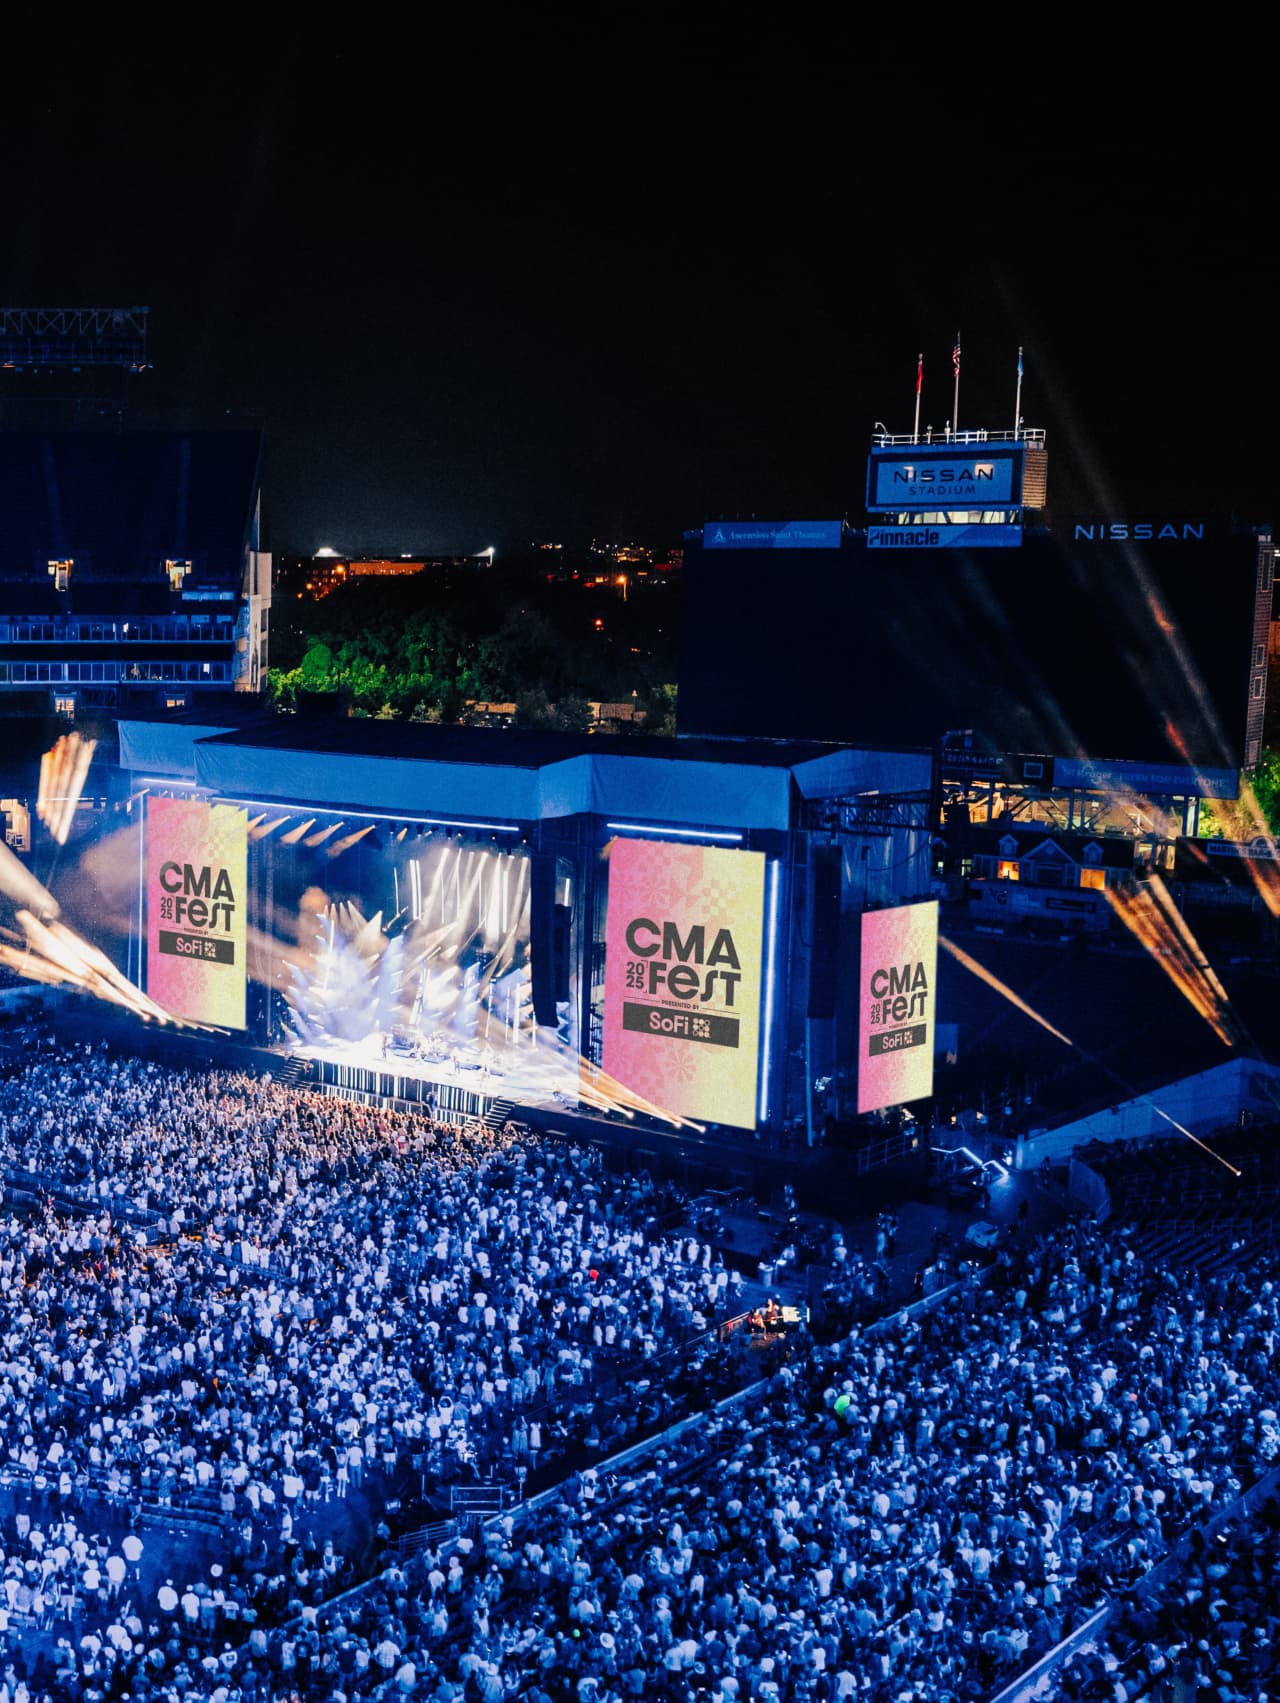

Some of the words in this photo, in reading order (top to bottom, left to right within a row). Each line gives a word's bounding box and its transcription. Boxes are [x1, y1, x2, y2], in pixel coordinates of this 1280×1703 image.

[894, 468, 994, 483] NISSAN
[909, 486, 976, 496] STADIUM
[869, 528, 939, 546] Pinnacle
[1074, 522, 1204, 541] NISSAN
[160, 861, 235, 902] CMA
[160, 897, 173, 908] 20
[160, 908, 173, 920] 25
[176, 937, 202, 955] SoFi
[625, 918, 741, 969] CMA
[626, 962, 645, 975] 20
[626, 975, 644, 989] 25
[870, 962, 928, 999] CMA
[661, 999, 691, 1009] PRESENTED
[649, 1011, 689, 1035] SoFi
[882, 1033, 903, 1049] SoFi
